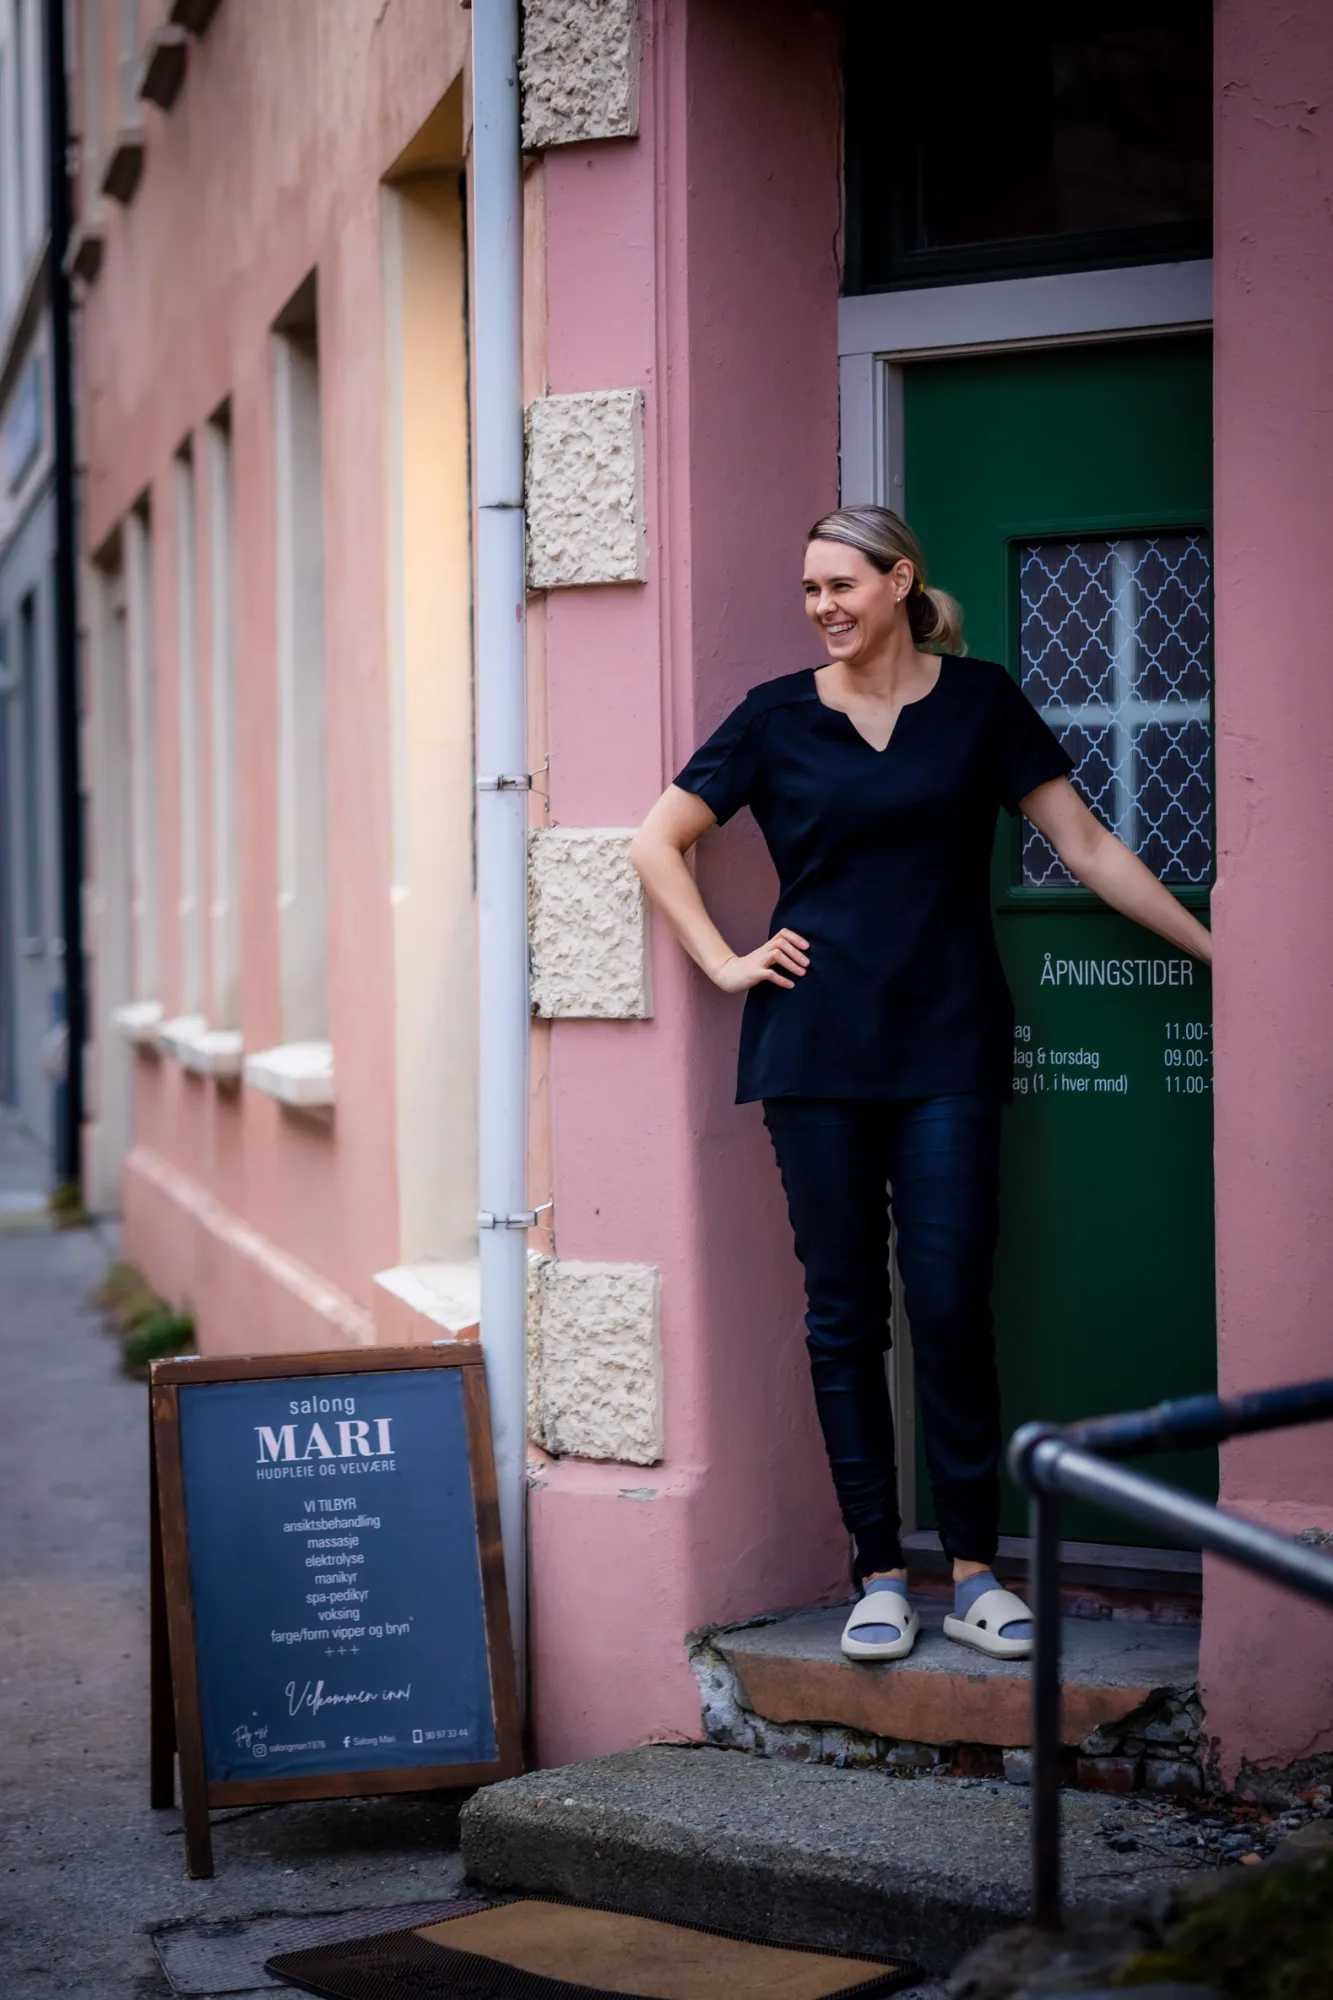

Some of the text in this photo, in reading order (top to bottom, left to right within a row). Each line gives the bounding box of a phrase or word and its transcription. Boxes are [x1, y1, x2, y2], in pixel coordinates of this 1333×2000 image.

[1040, 952, 1194, 986] ÅPNINGSTIDER
[1014, 1024, 1031, 1042] ag
[1037, 1047, 1046, 1065] &
[1050, 1047, 1100, 1069] torsdag
[1012, 1072, 1128, 1095] ag (1. i hver mnd)
[290, 1395, 355, 1415] salong
[254, 1417, 396, 1463] MARI
[256, 1460, 397, 1480] HUDPLEIE OG VELVÆRE
[304, 1497, 357, 1513] VI TILBYR
[283, 1514, 381, 1532] ansiktsbehandling
[307, 1534, 359, 1549] massasje
[305, 1553, 364, 1567] elektrolyse
[315, 1571, 358, 1585] manikyr
[306, 1588, 370, 1606] spa-pedikyr
[318, 1607, 360, 1621] voksing
[271, 1622, 410, 1644] farge/form vipper og bryn
[285, 1680, 378, 1716] Velkommen
